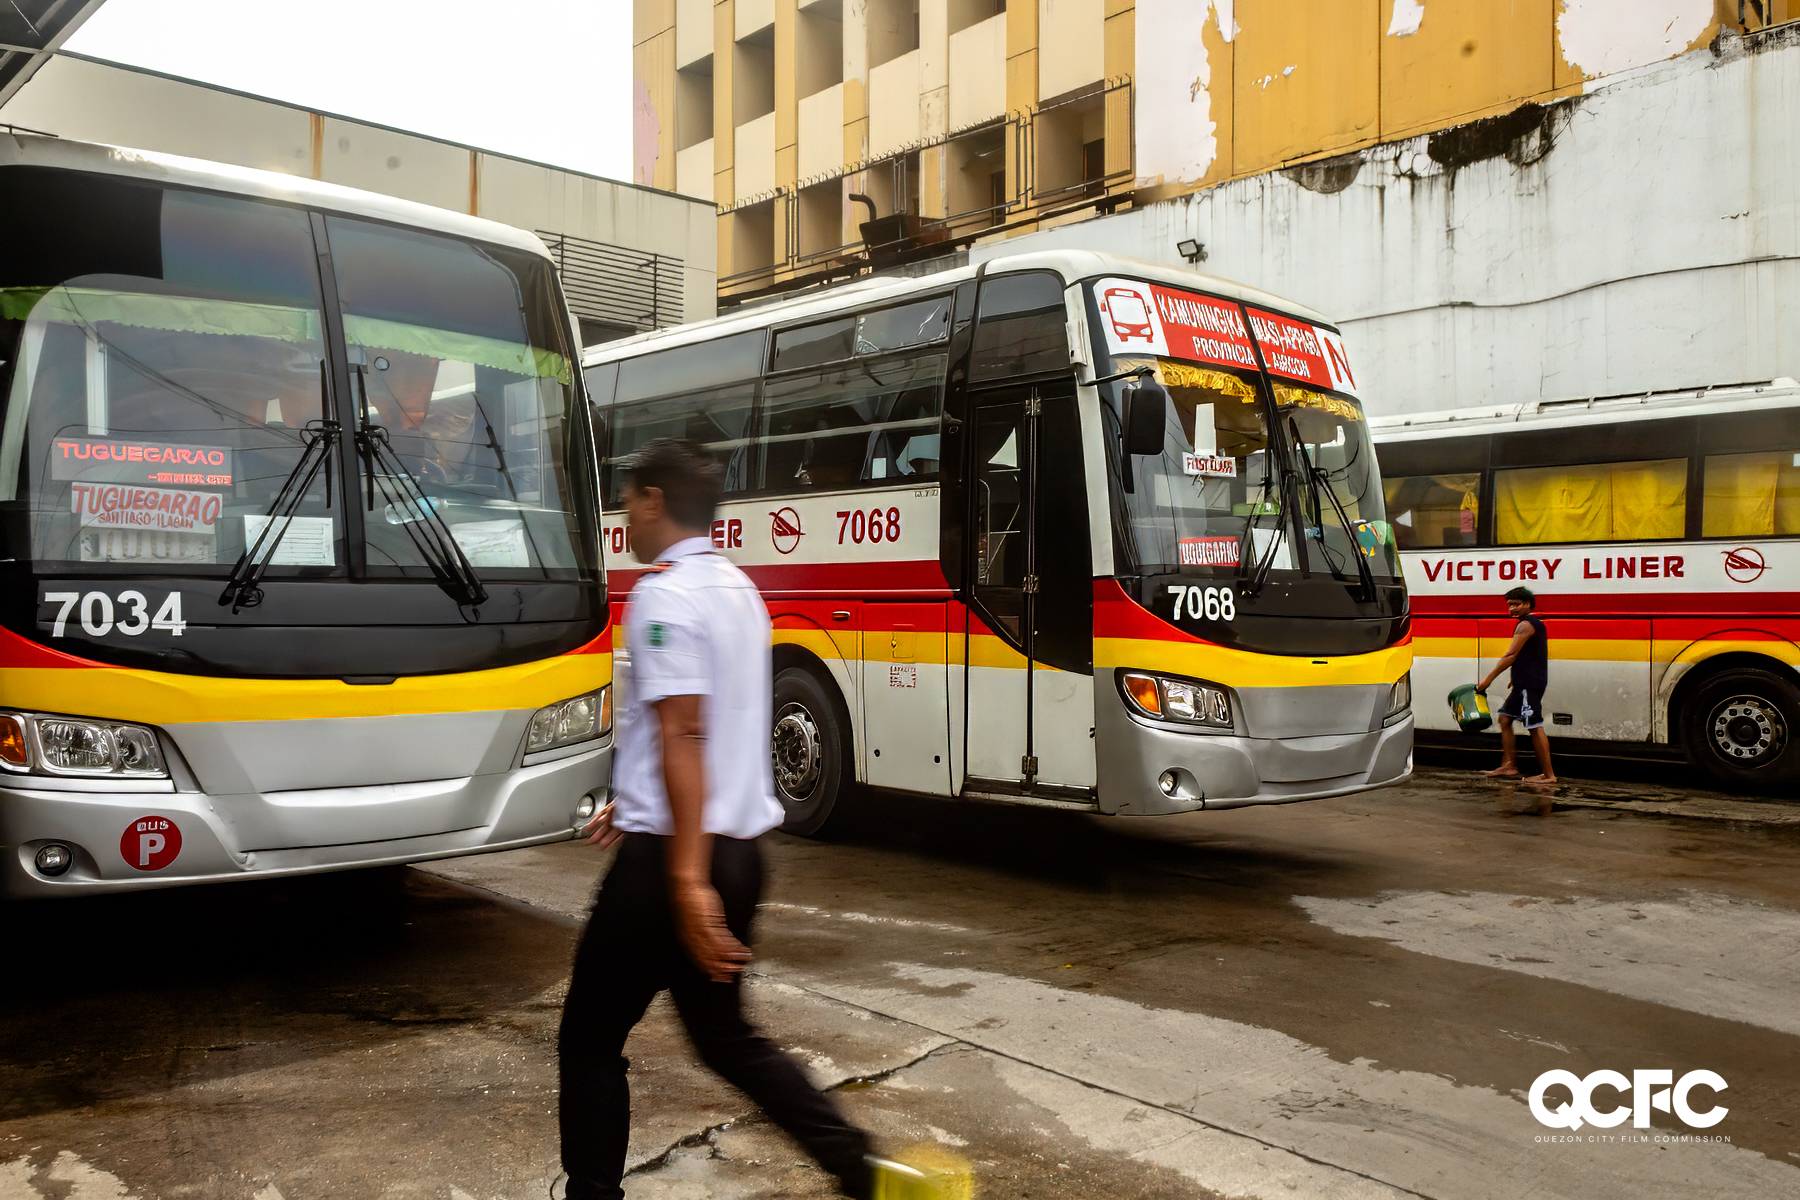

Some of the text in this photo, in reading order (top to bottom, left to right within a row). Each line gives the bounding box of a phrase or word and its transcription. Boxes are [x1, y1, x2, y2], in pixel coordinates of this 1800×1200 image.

[58, 442, 225, 465] TUGUEGARAO
[72, 486, 220, 526] TUGUEGARAO
[836, 507, 901, 544] 7068
[1421, 555, 1685, 582] VICTORY LINER
[44, 590, 187, 638] 7034
[1167, 585, 1236, 622] 7068
[139, 833, 166, 866] P
